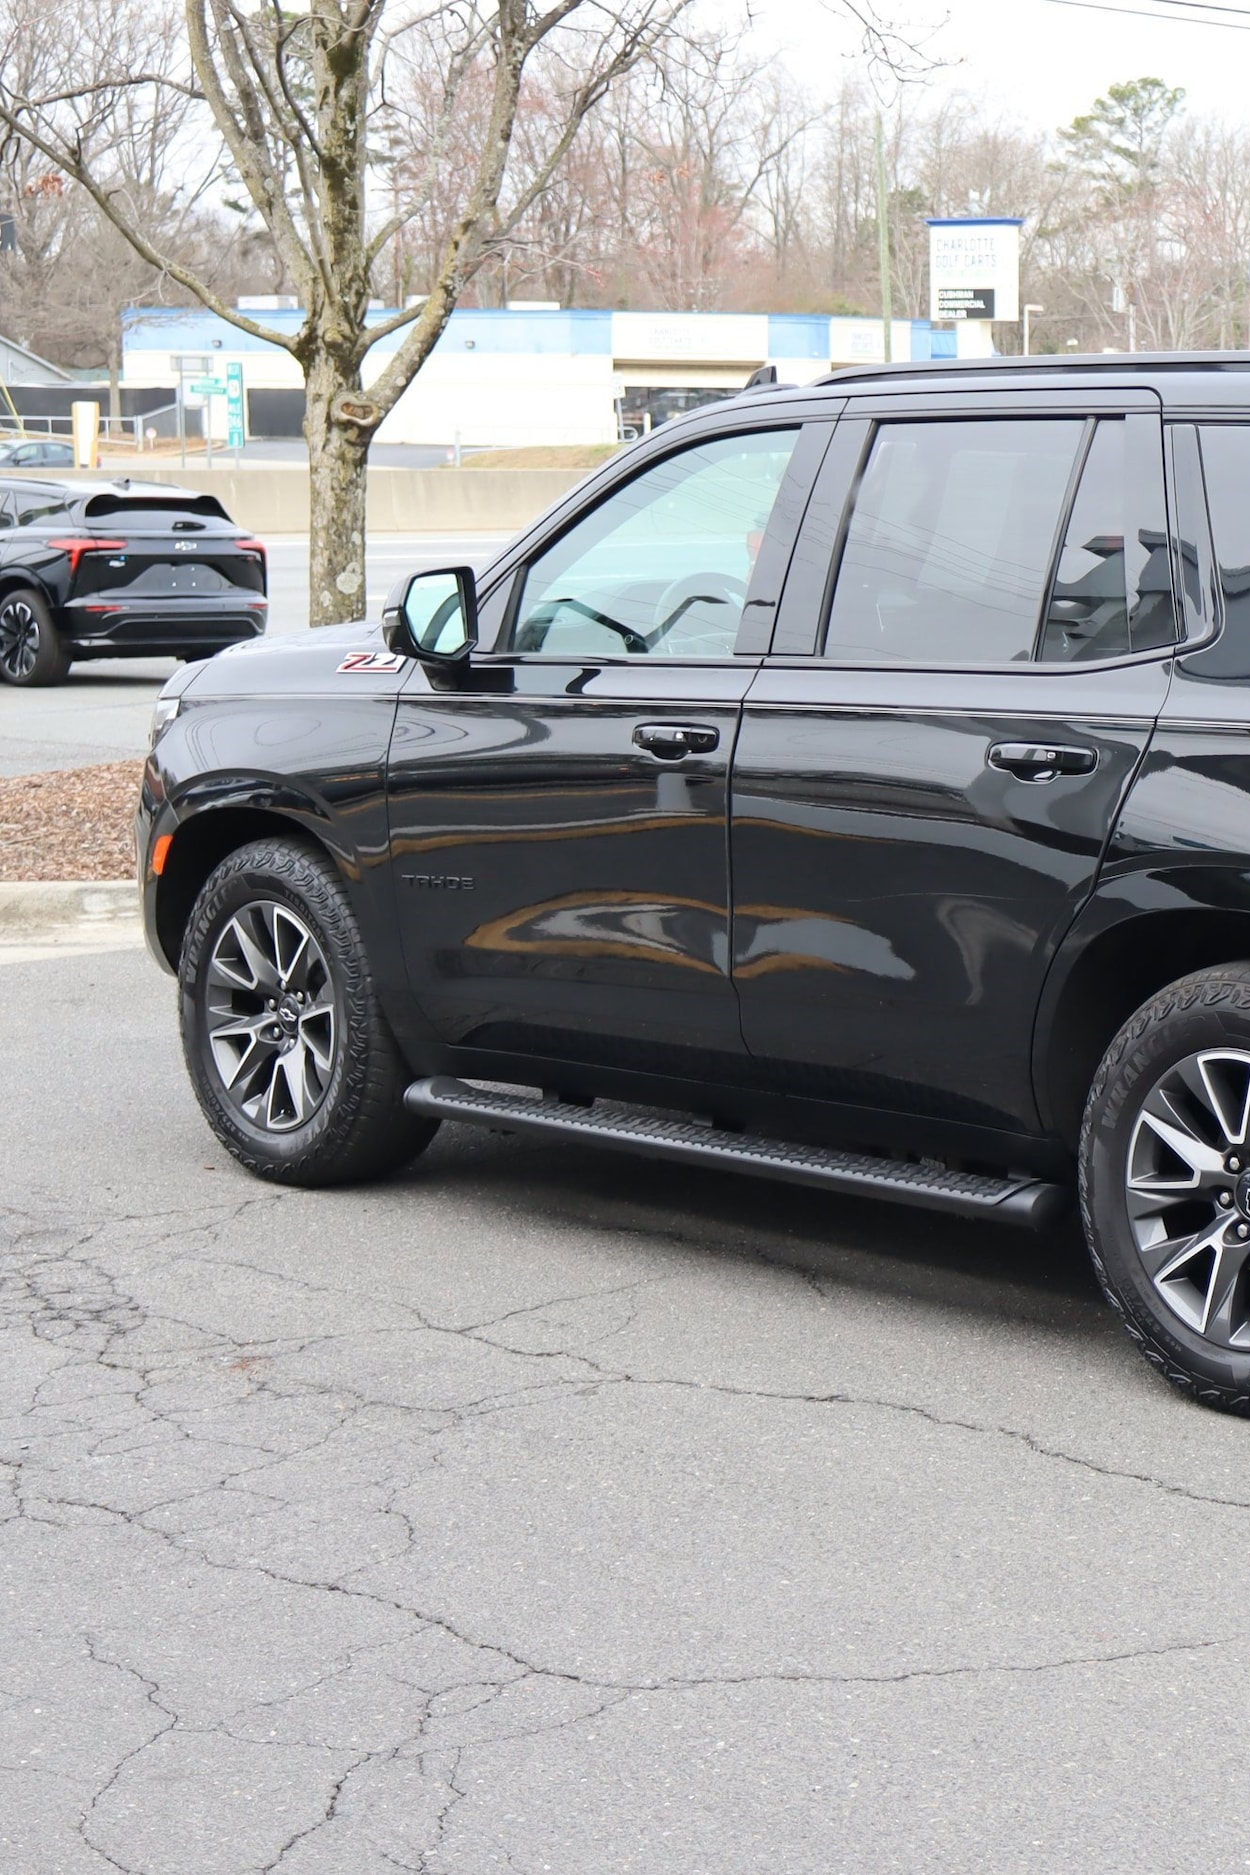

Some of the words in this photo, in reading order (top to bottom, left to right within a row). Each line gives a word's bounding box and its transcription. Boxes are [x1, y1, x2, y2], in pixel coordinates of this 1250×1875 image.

[936, 238, 996, 252] CHARLOTTE
[935, 254, 960, 268] GOLF
[964, 254, 998, 268] CARTS
[938, 299, 986, 309] COMMERCIAL
[401, 874, 474, 890] TAHOE
